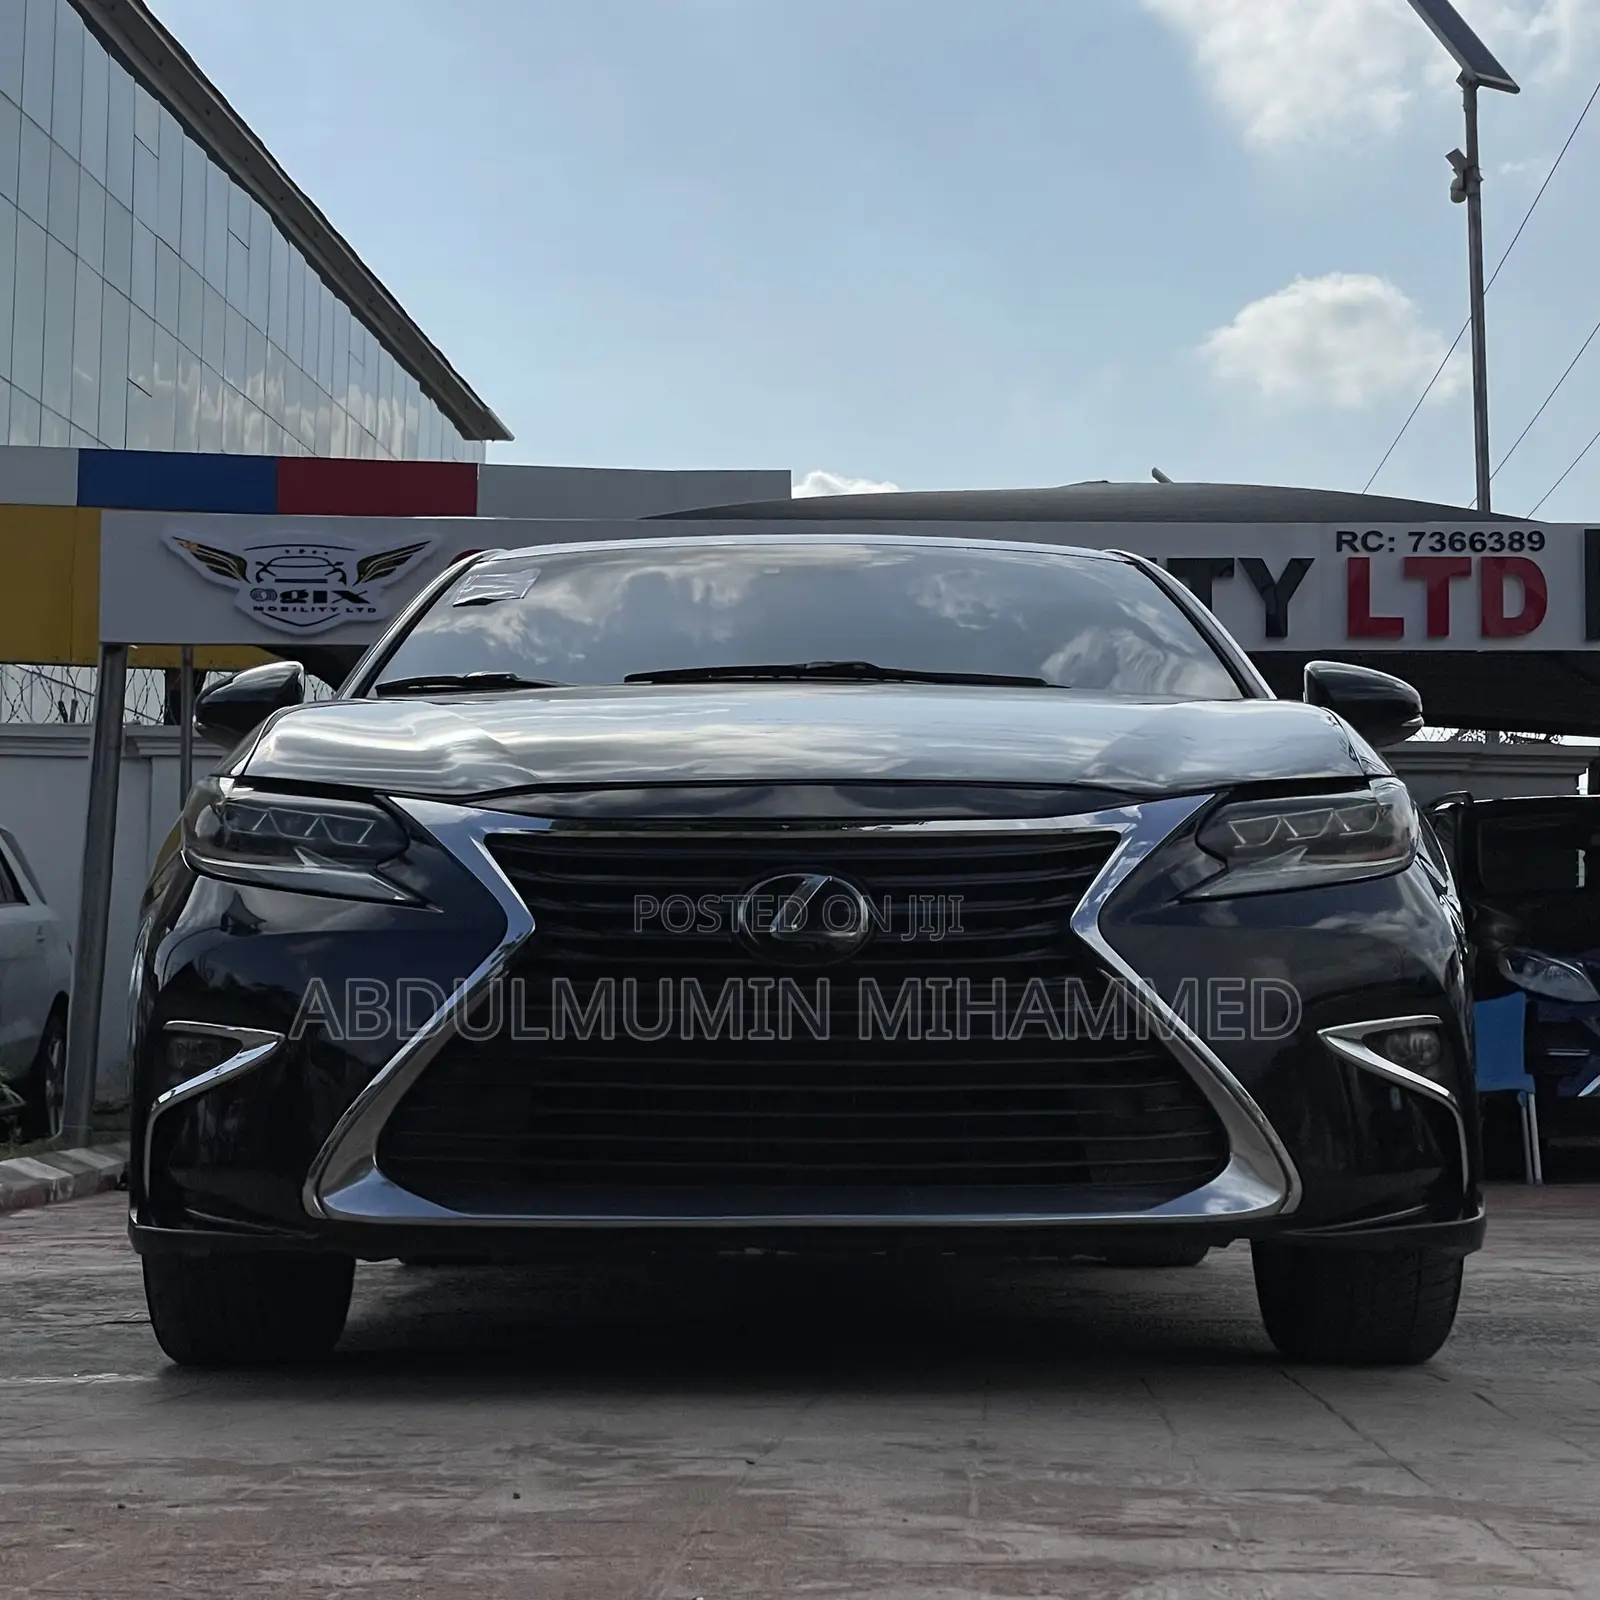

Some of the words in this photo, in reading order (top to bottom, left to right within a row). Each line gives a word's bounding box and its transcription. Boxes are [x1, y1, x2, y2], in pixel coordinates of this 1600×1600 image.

[1336, 530, 1396, 552] RC:
[1407, 530, 1546, 552] 7366389
[1346, 556, 1549, 637] LTD
[252, 605, 339, 613] MOBILITY
[345, 606, 377, 614] LTD
